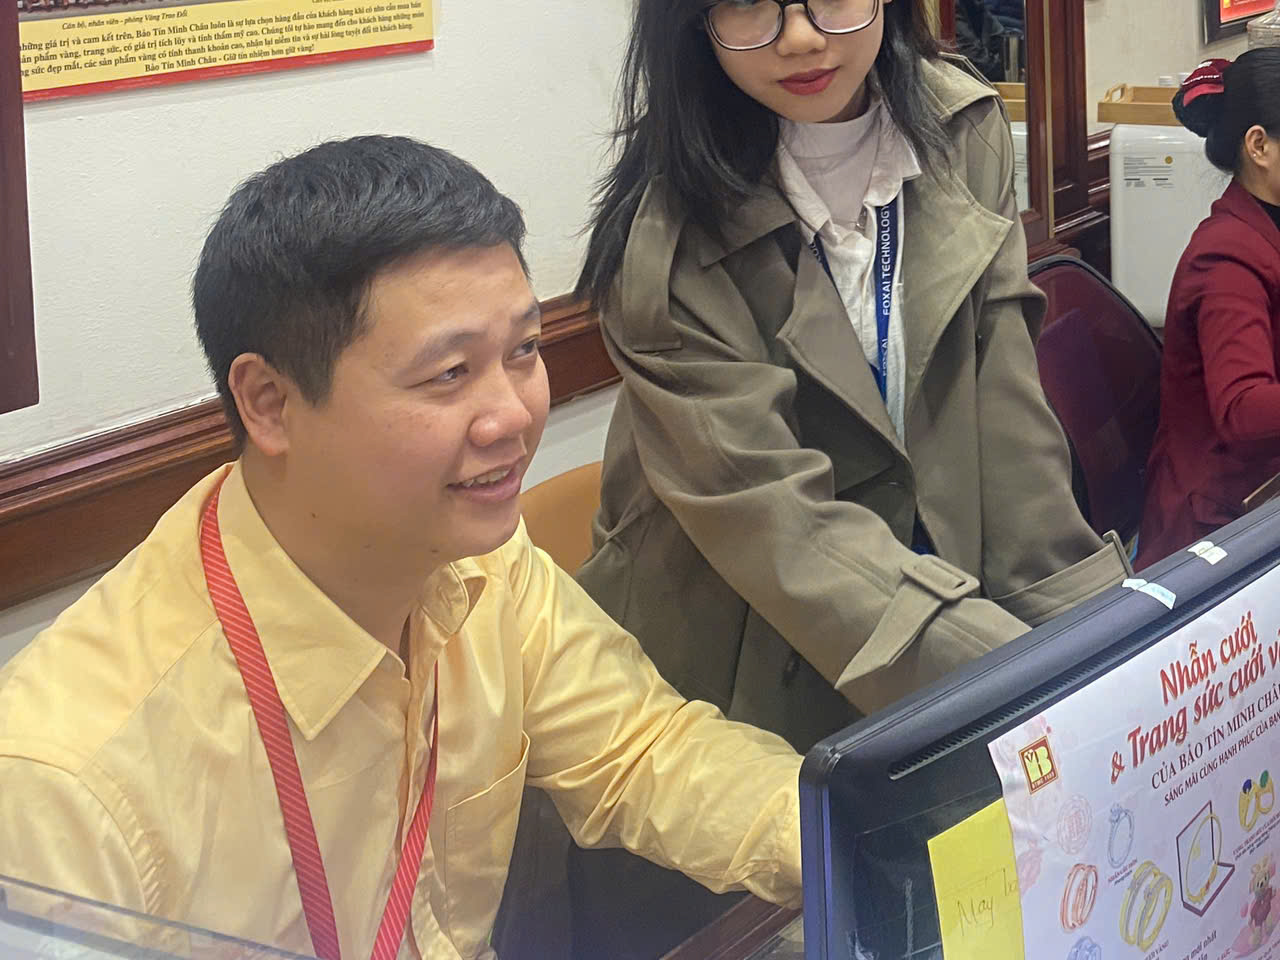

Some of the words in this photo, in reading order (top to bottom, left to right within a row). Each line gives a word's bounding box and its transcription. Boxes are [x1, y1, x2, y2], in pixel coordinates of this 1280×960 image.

[880, 205, 891, 278] TECHNOLOGY
[882, 278, 891, 316] FOXAI
[1160, 640, 1217, 706] Nhẫn
[1220, 610, 1259, 665] cưới
[1110, 750, 1125, 784] &
[1128, 706, 1188, 769] Trang
[1193, 680, 1224, 724] sức
[1228, 644, 1266, 698] cưới
[1151, 761, 1178, 790] CỦA
[1180, 741, 1204, 776] BẢO
[1204, 725, 1225, 752] TÍN
[1226, 707, 1256, 737] MINH
[1164, 786, 1185, 807] SÁNG
[1184, 772, 1199, 791] MÃI
[1199, 758, 1219, 783] CÙNG
[1219, 745, 1238, 768] HẠNH
[1238, 731, 1256, 752] PHÚC
[1255, 720, 1269, 738] CỦA
